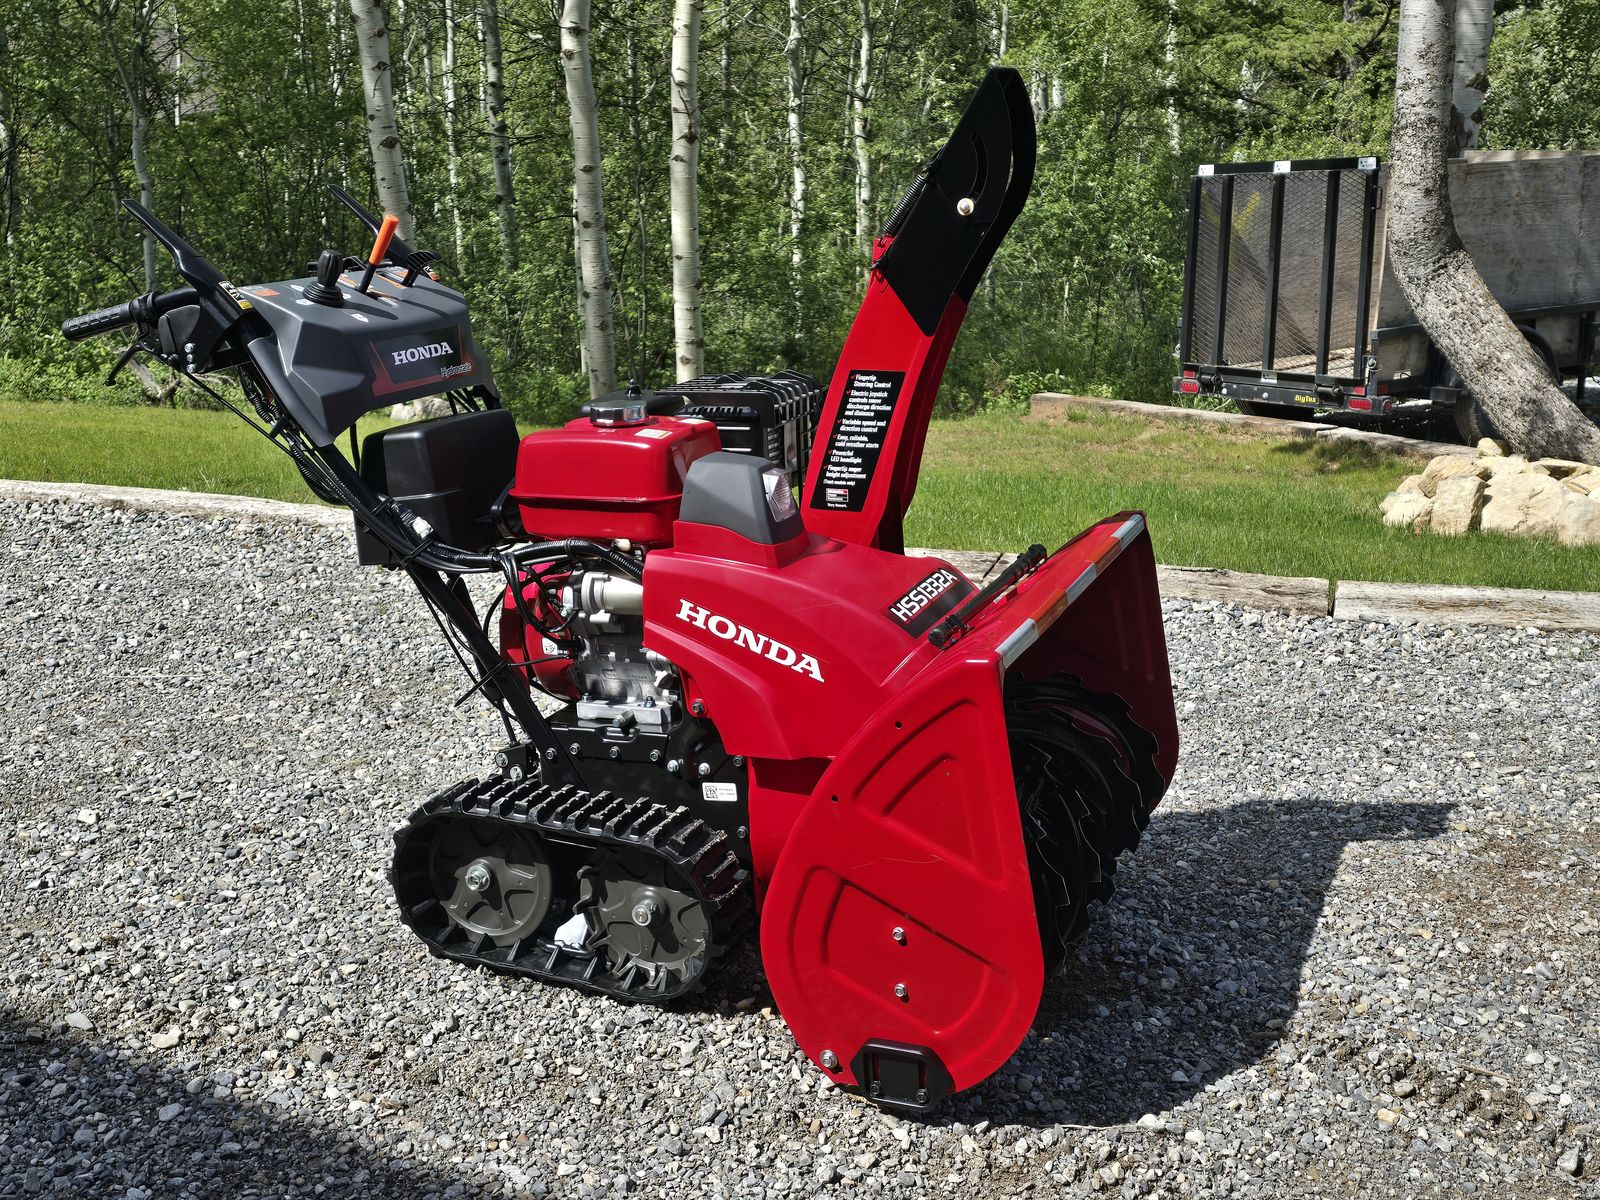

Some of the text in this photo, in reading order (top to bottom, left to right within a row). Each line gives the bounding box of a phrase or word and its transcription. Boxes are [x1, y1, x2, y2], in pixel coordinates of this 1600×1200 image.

[392, 341, 454, 366] HONDA
[855, 373, 877, 382] Fingertip
[853, 380, 874, 389] Steering
[869, 390, 888, 398] joystick
[1295, 394, 1317, 403] BigTex
[846, 402, 892, 411] discharge direction
[832, 449, 854, 457] Powerful
[839, 456, 863, 465] headlight
[828, 464, 848, 473] Fingertip
[825, 470, 867, 480] height adjustment
[890, 569, 957, 621] HSS1332A
[675, 598, 825, 683] HONDA
